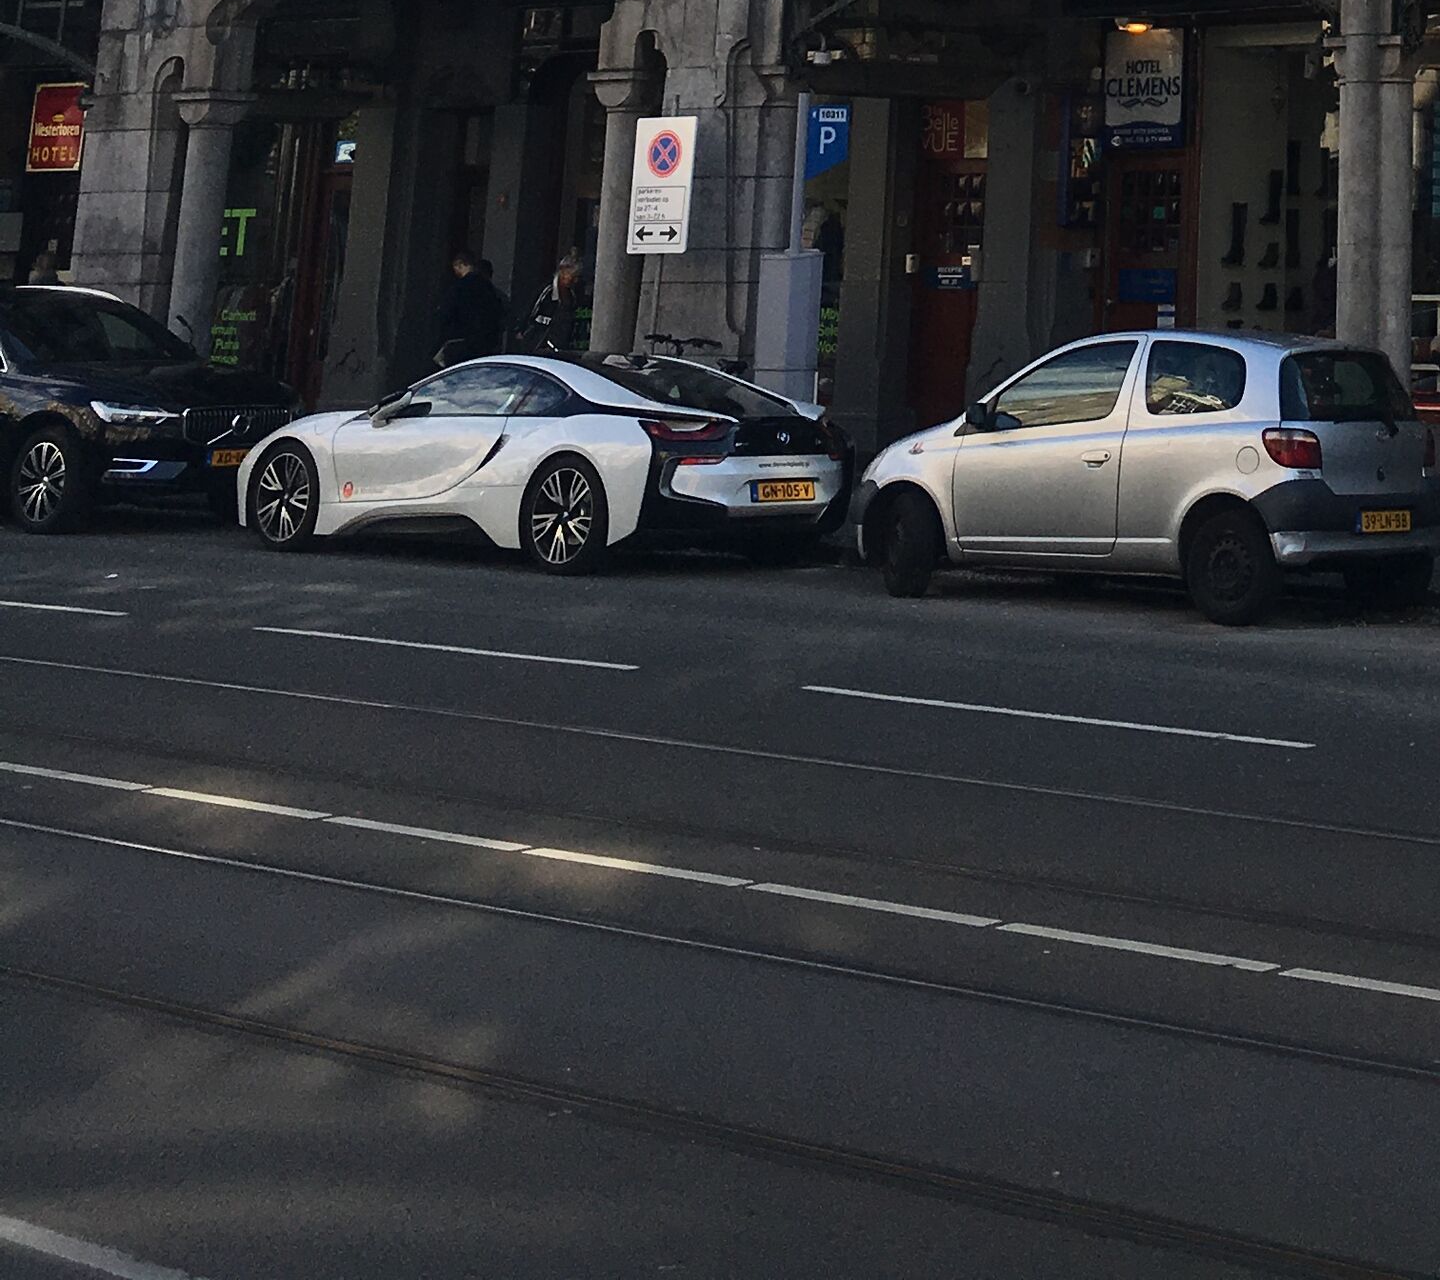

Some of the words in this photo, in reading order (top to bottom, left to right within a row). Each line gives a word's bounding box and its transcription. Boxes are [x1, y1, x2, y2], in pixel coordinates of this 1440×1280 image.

[1126, 60, 1162, 74] HOTEL
[1106, 76, 1180, 97] CLEMENS
[821, 110, 845, 119] 10311
[819, 126, 836, 154] P
[921, 132, 959, 153] VUE
[32, 145, 75, 162] HOTEL
[762, 484, 810, 498] GN-105-V
[1364, 512, 1408, 530] 39-LN-BB
